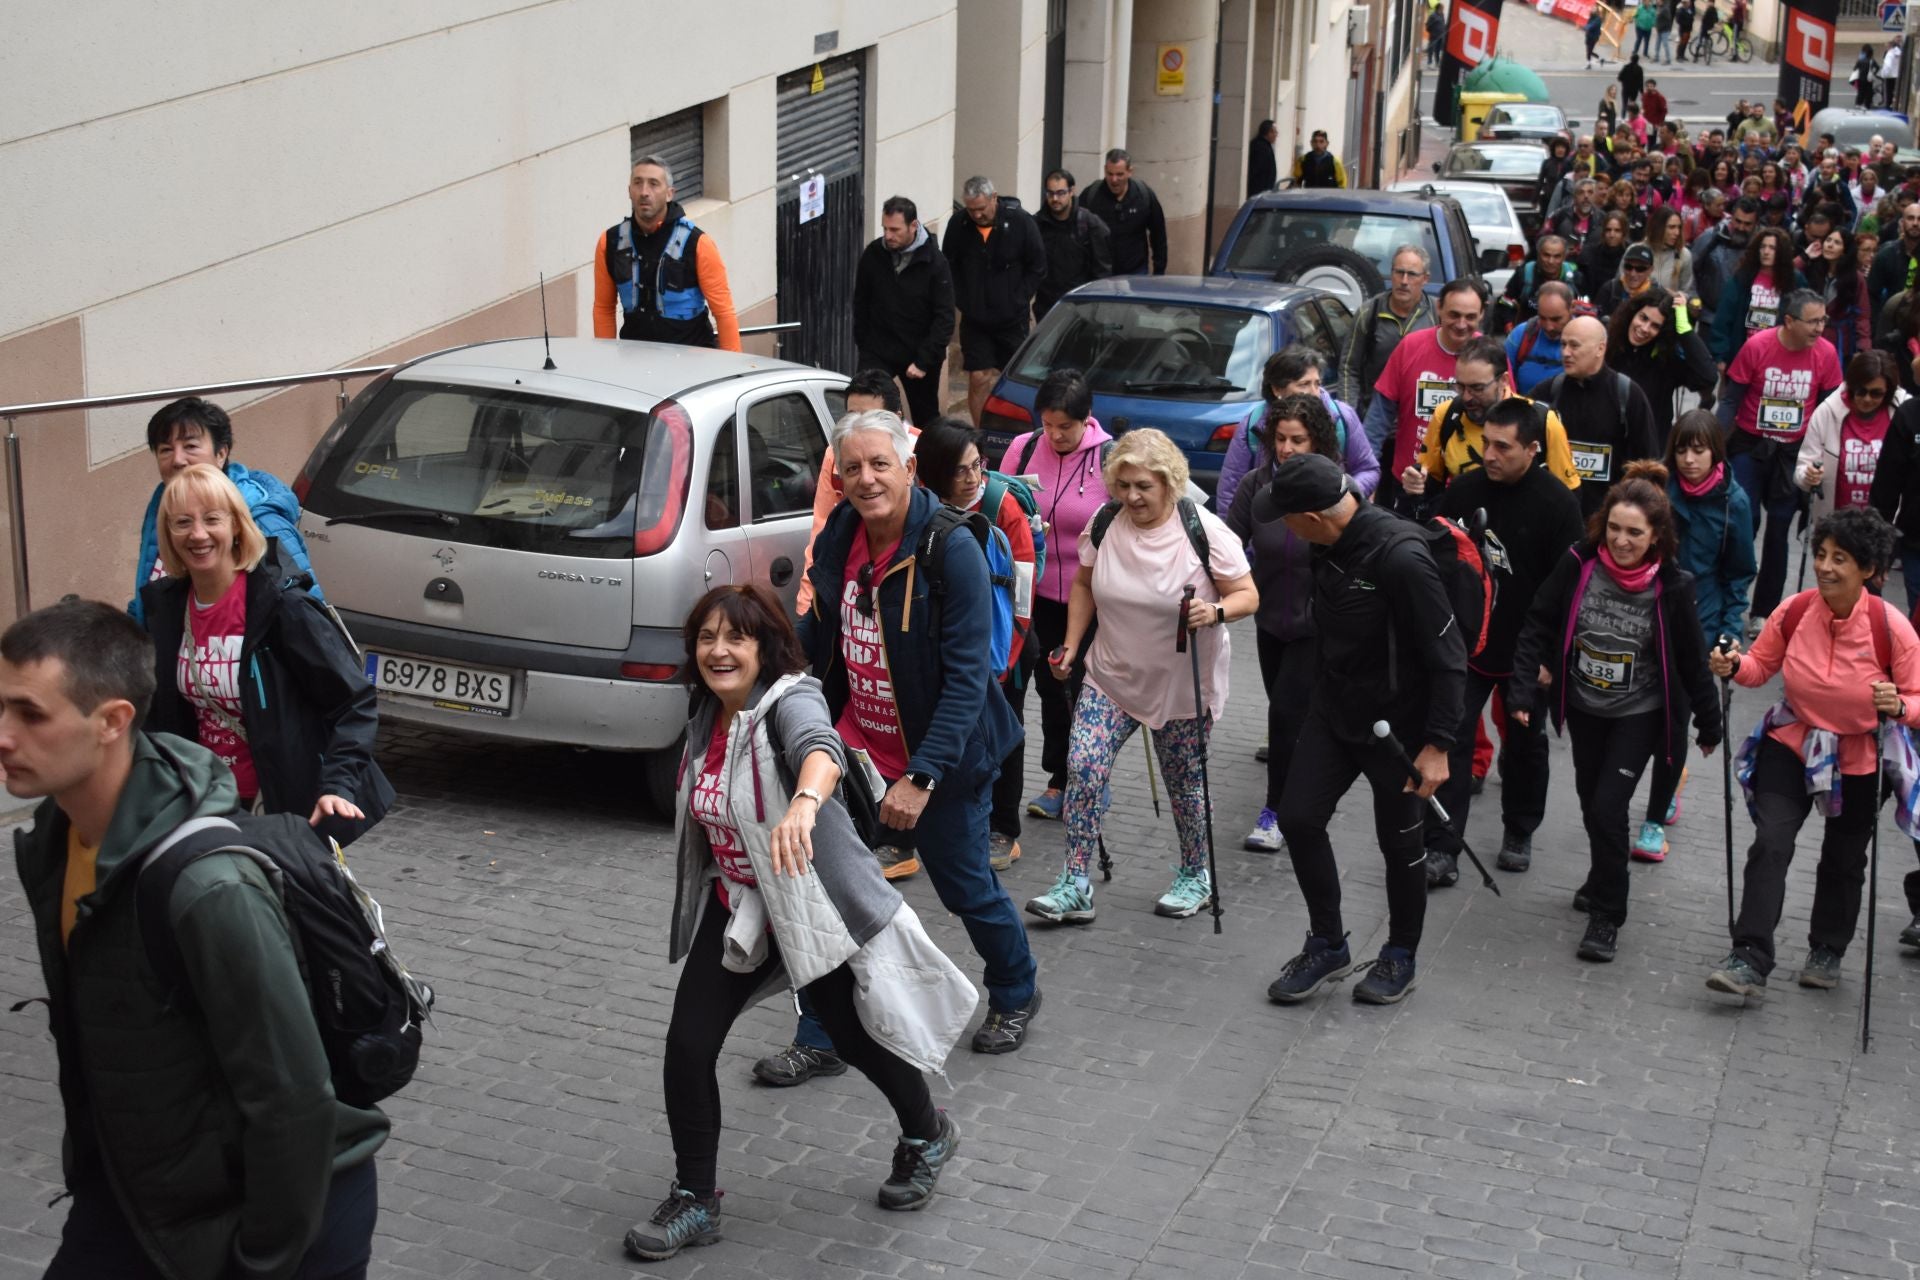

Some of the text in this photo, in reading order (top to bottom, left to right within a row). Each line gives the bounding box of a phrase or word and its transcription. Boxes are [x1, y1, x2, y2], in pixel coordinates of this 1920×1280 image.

[1771, 410, 1793, 421] 610
[354, 461, 400, 480] OPEL
[1573, 457, 1598, 469] 507
[535, 489, 594, 507] Tudasa
[537, 570, 586, 583] CORSA
[1585, 661, 1615, 680] 538
[383, 659, 503, 703] 6978 BXS
[471, 706, 503, 716] TUDASA
